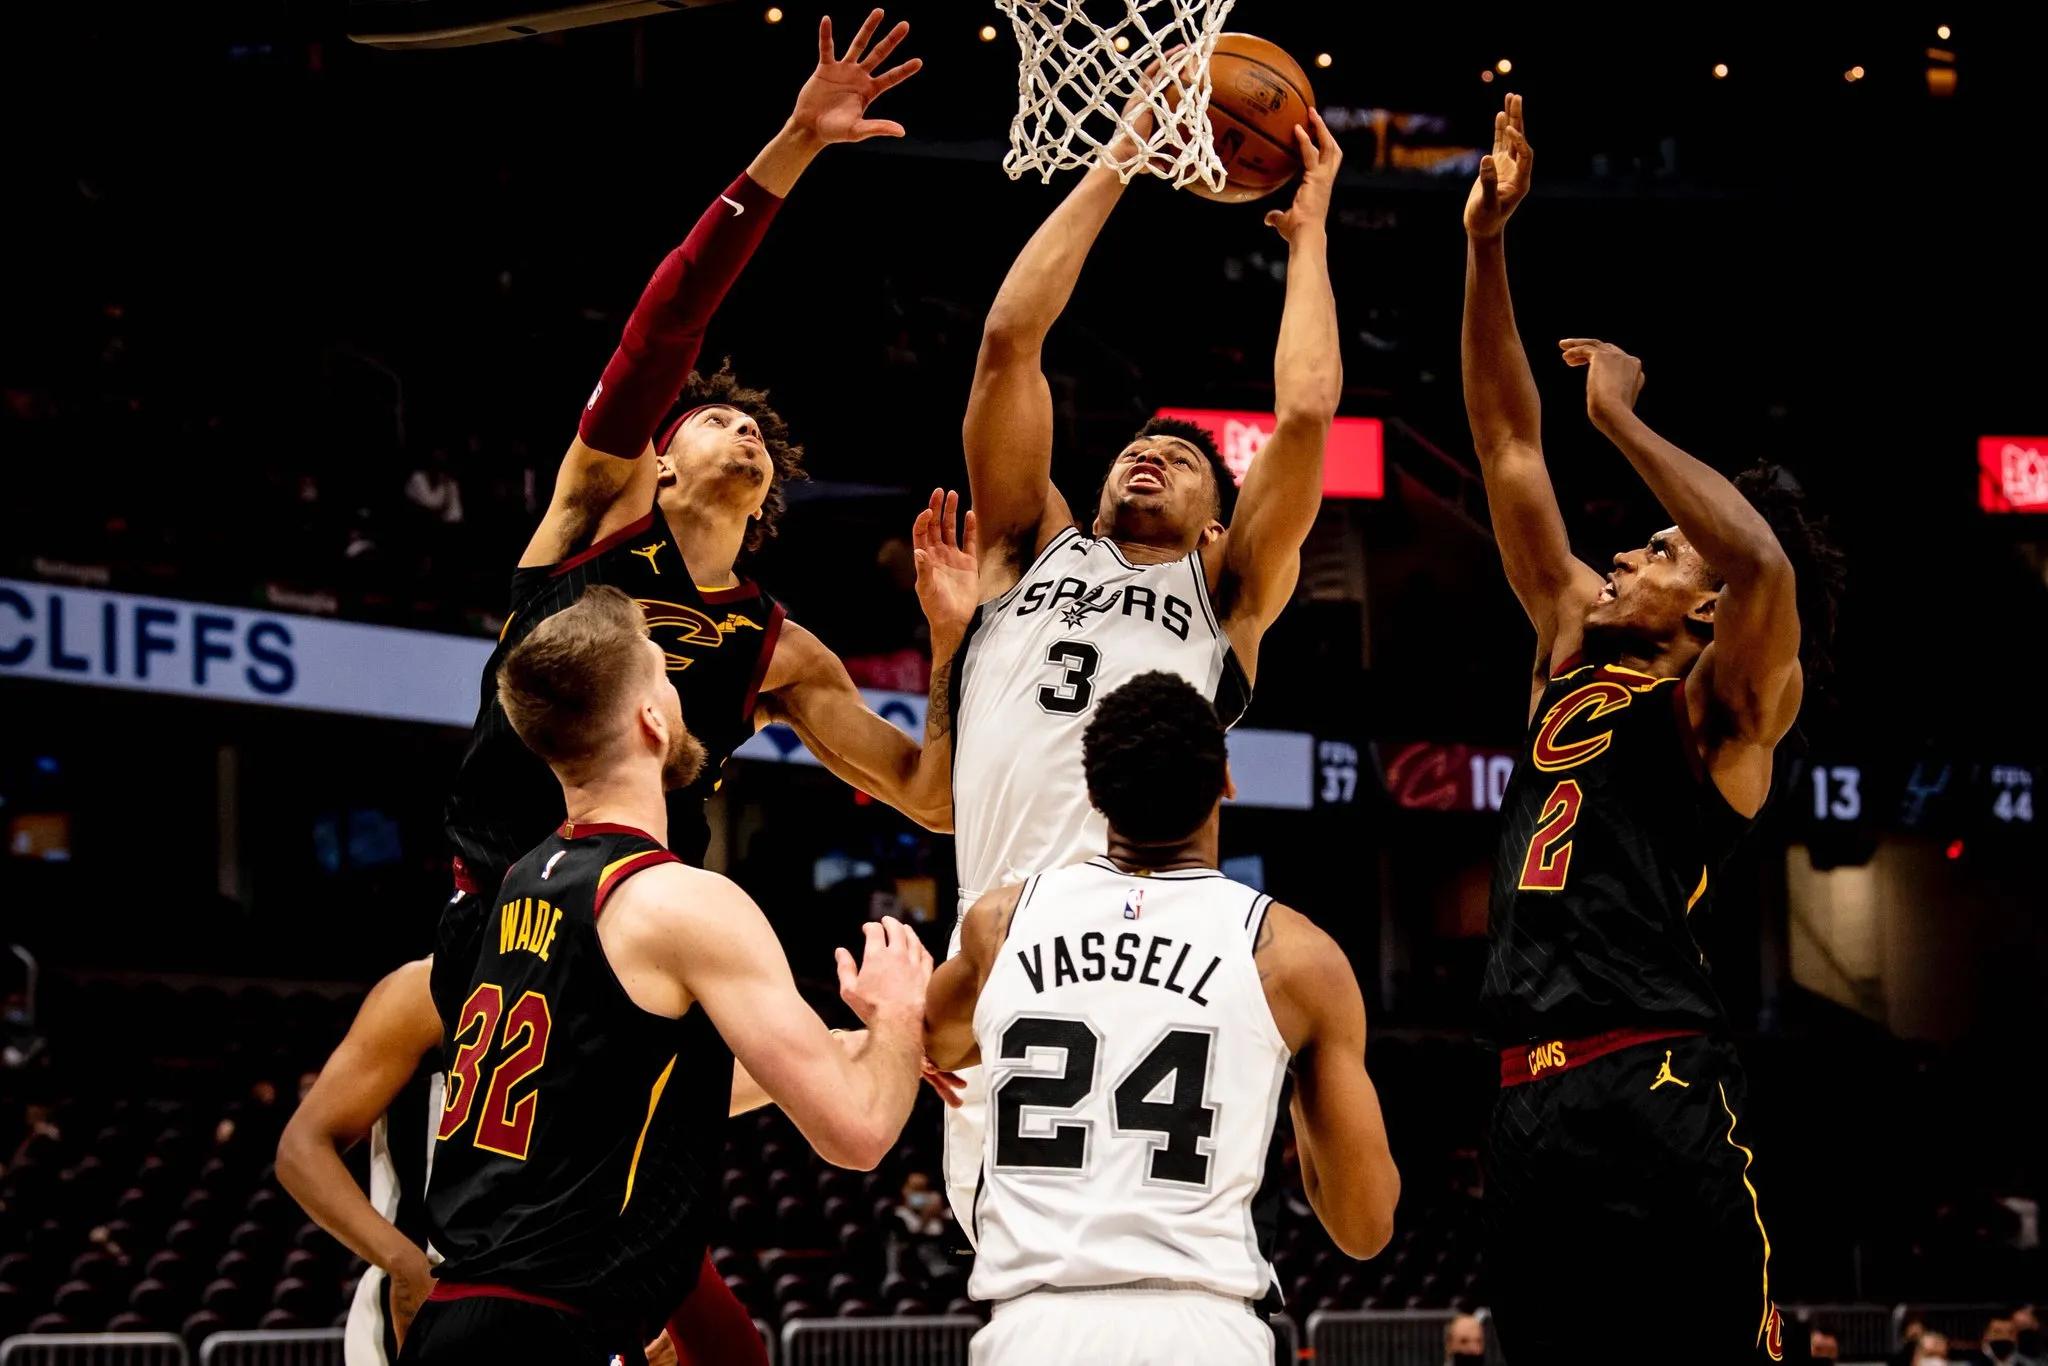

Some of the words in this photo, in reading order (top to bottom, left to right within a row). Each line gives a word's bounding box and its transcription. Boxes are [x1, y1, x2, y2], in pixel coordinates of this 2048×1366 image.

[0, 586, 296, 695] CLIFFS
[1017, 577, 1193, 641] SPURS
[1036, 639, 1102, 716] 3
[1321, 767, 1358, 802] 37
[1470, 754, 1515, 810] 10
[1812, 766, 1861, 820] 13
[1518, 779, 1583, 890] 2
[499, 897, 564, 962] WADE
[1017, 931, 1222, 1007] VASSELL
[436, 982, 552, 1161] 32
[1528, 1041, 1567, 1076] CAVS
[991, 1010, 1223, 1193] 24
